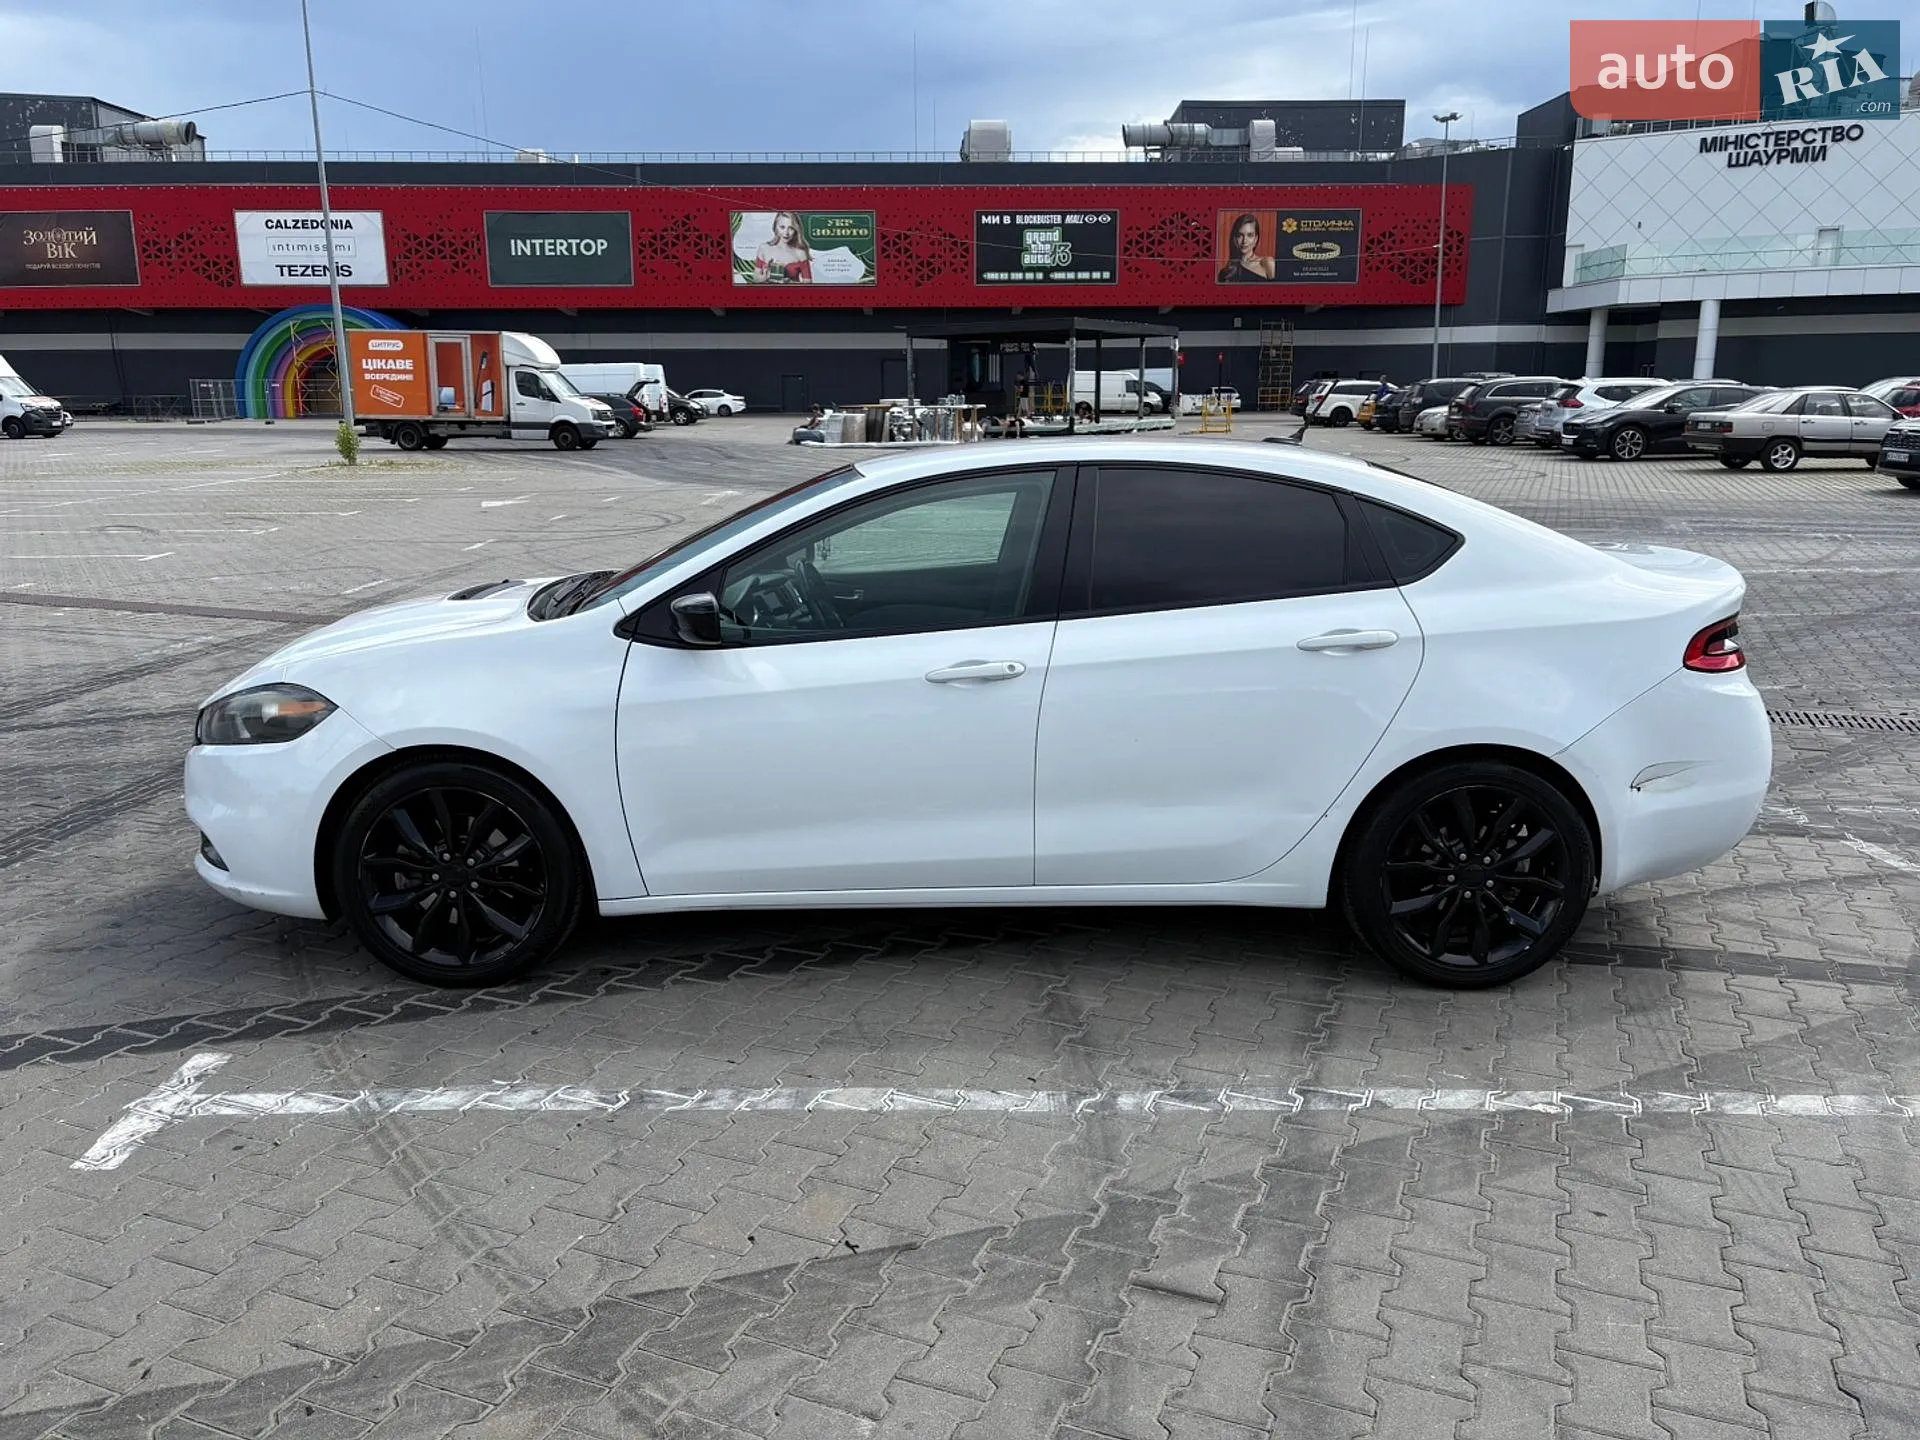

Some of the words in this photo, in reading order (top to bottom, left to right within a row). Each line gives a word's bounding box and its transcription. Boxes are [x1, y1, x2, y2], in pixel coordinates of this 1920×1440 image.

[1699, 124, 1864, 153] МІНІСТЕРСТВО
[1727, 145, 1828, 168] ШАУРМИ
[1016, 214, 1062, 224] BLOCKBUSTER
[272, 243, 351, 252] intimissmi
[510, 239, 608, 256] INTERTOP
[362, 358, 414, 370] ЦІКАВЕ
